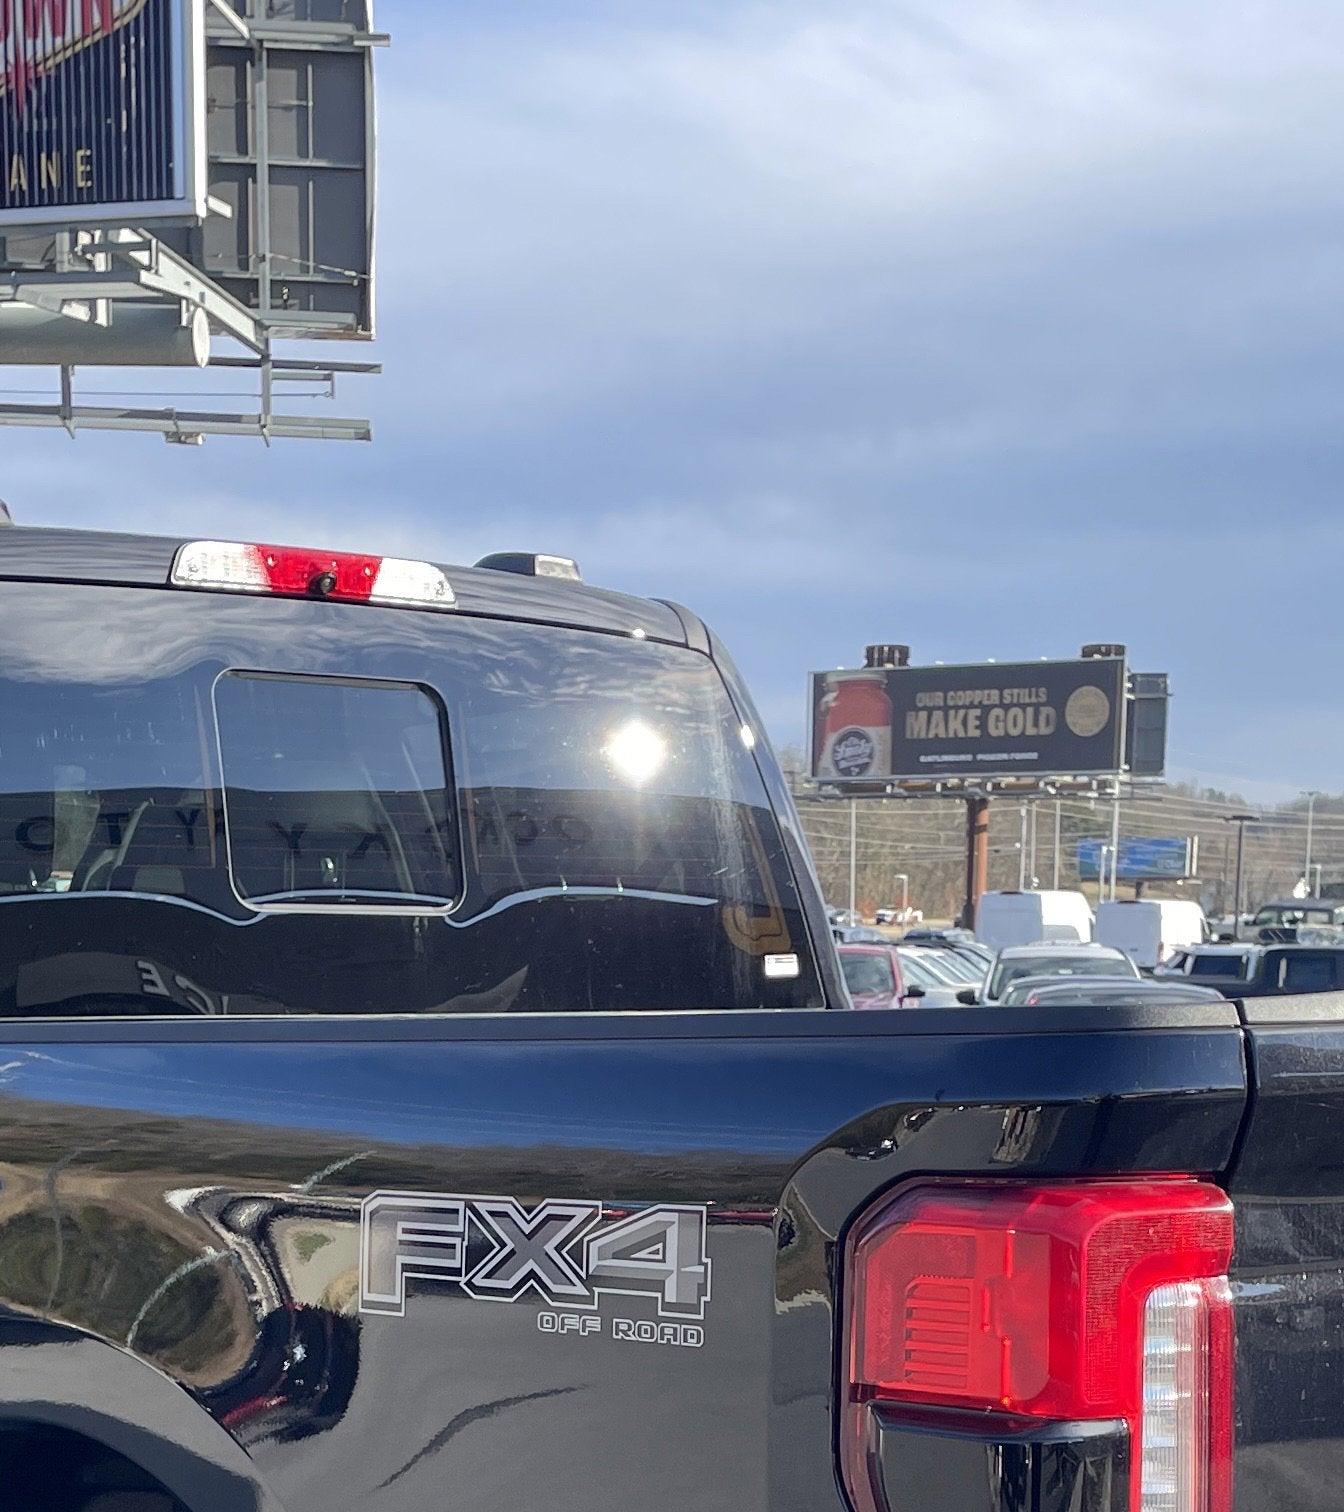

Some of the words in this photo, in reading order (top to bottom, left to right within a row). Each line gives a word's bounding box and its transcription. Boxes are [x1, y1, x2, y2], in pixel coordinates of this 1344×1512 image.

[916, 692, 944, 708] OUR
[947, 689, 1000, 706] COPPER
[1003, 687, 1047, 704] STILLS
[906, 708, 981, 740] MAKE
[987, 706, 1057, 738] GOLD
[358, 1189, 711, 1319] FX4
[537, 1311, 601, 1336] OFF
[612, 1318, 704, 1348] ROAD
